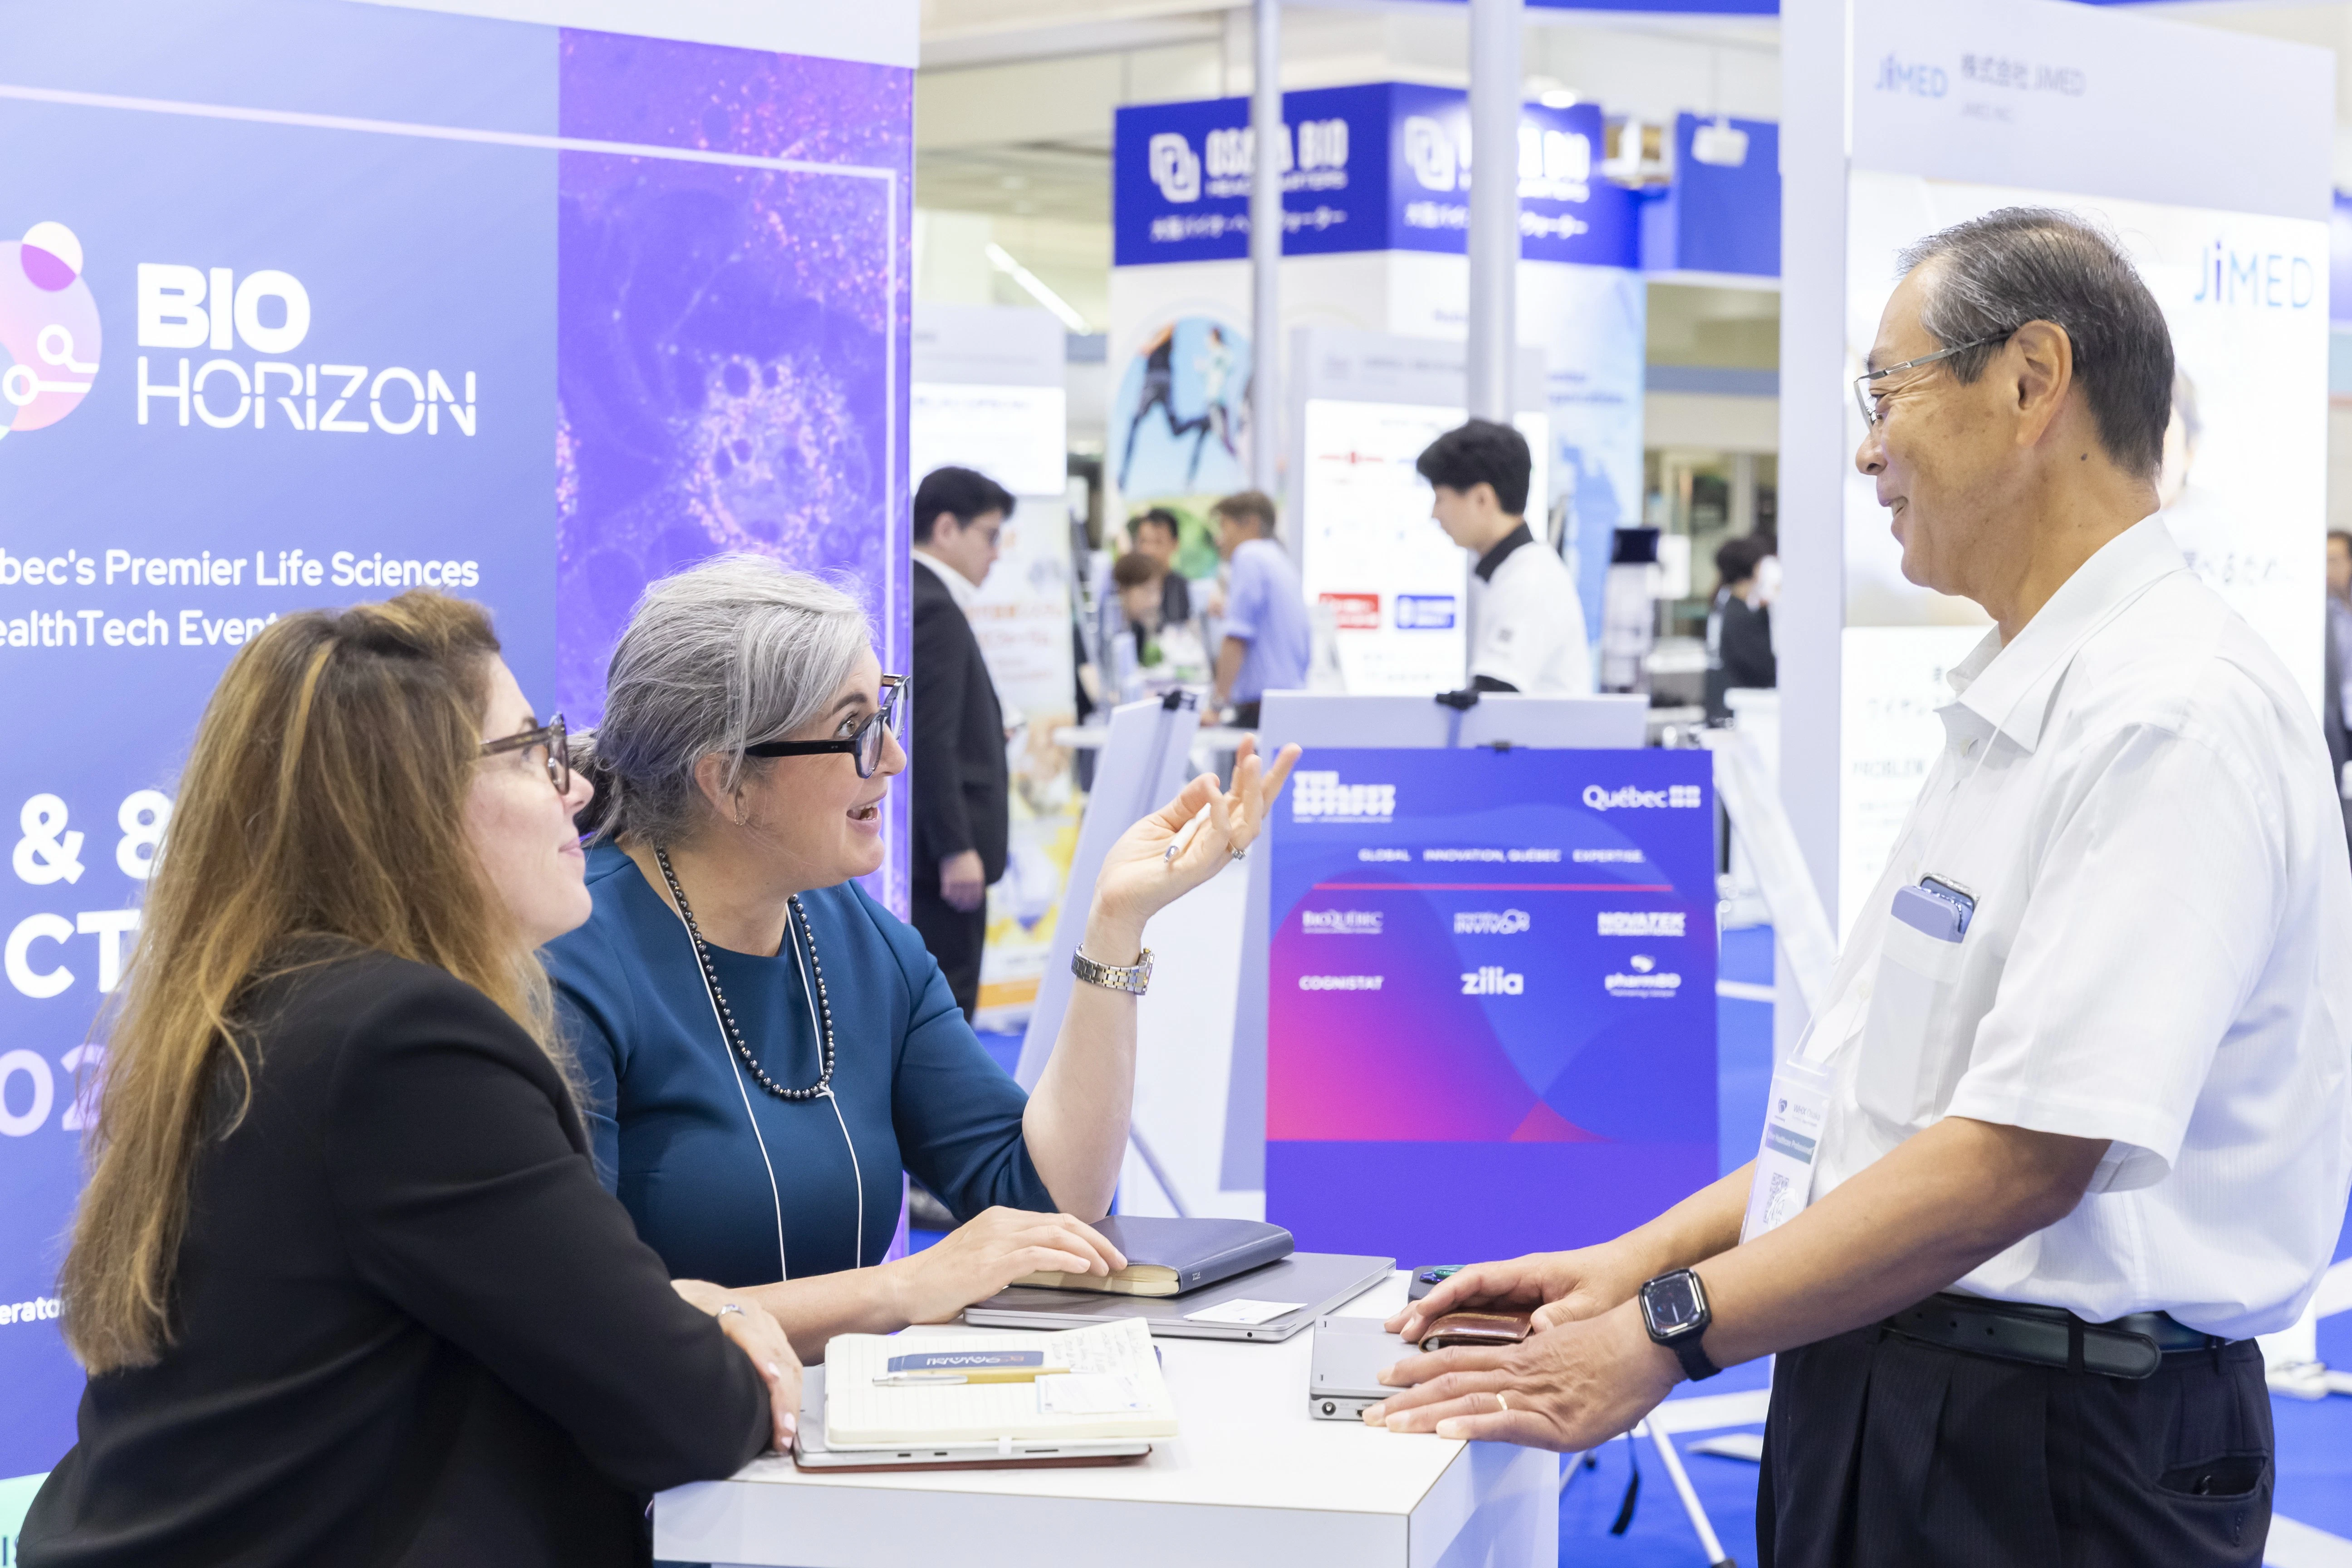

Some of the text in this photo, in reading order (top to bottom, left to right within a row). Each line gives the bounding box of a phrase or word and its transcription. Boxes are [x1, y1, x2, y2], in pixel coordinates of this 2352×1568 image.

[137, 263, 310, 354] BIO
[137, 356, 476, 436] HORIZON
[105, 549, 248, 586] Premier
[256, 549, 324, 586] Life
[331, 551, 480, 588] Sciences
[1582, 784, 1668, 811] Québec
[12, 789, 173, 886] & 8
[1357, 847, 1412, 863] GLOBAL
[4, 910, 142, 999] CT
[1298, 975, 1384, 990] COGNISTAT
[1461, 966, 1524, 995] zilia
[0, 1296, 65, 1325] erato
